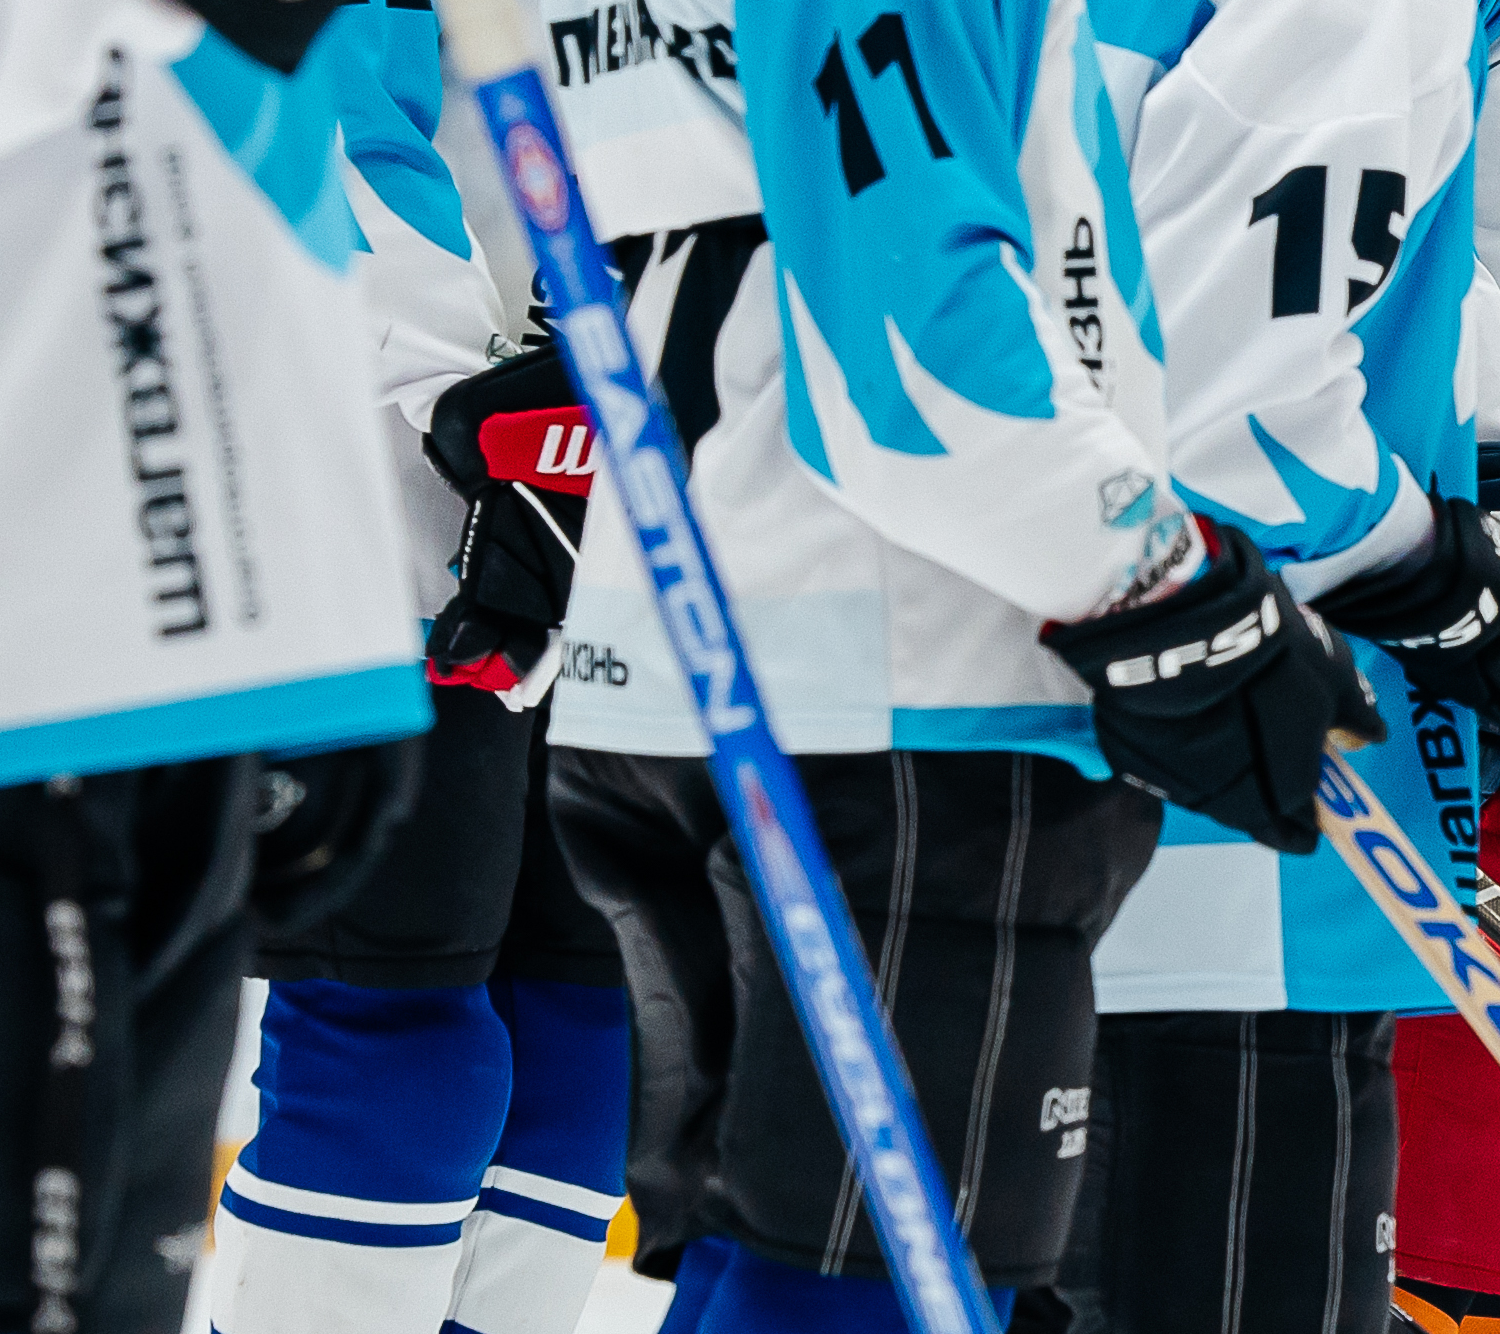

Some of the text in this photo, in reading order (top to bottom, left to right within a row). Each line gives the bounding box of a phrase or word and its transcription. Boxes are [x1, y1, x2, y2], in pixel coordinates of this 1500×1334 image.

[1247, 165, 1407, 320] 15
[560, 303, 758, 737] EASTON
[1105, 592, 1281, 689] EFSI
